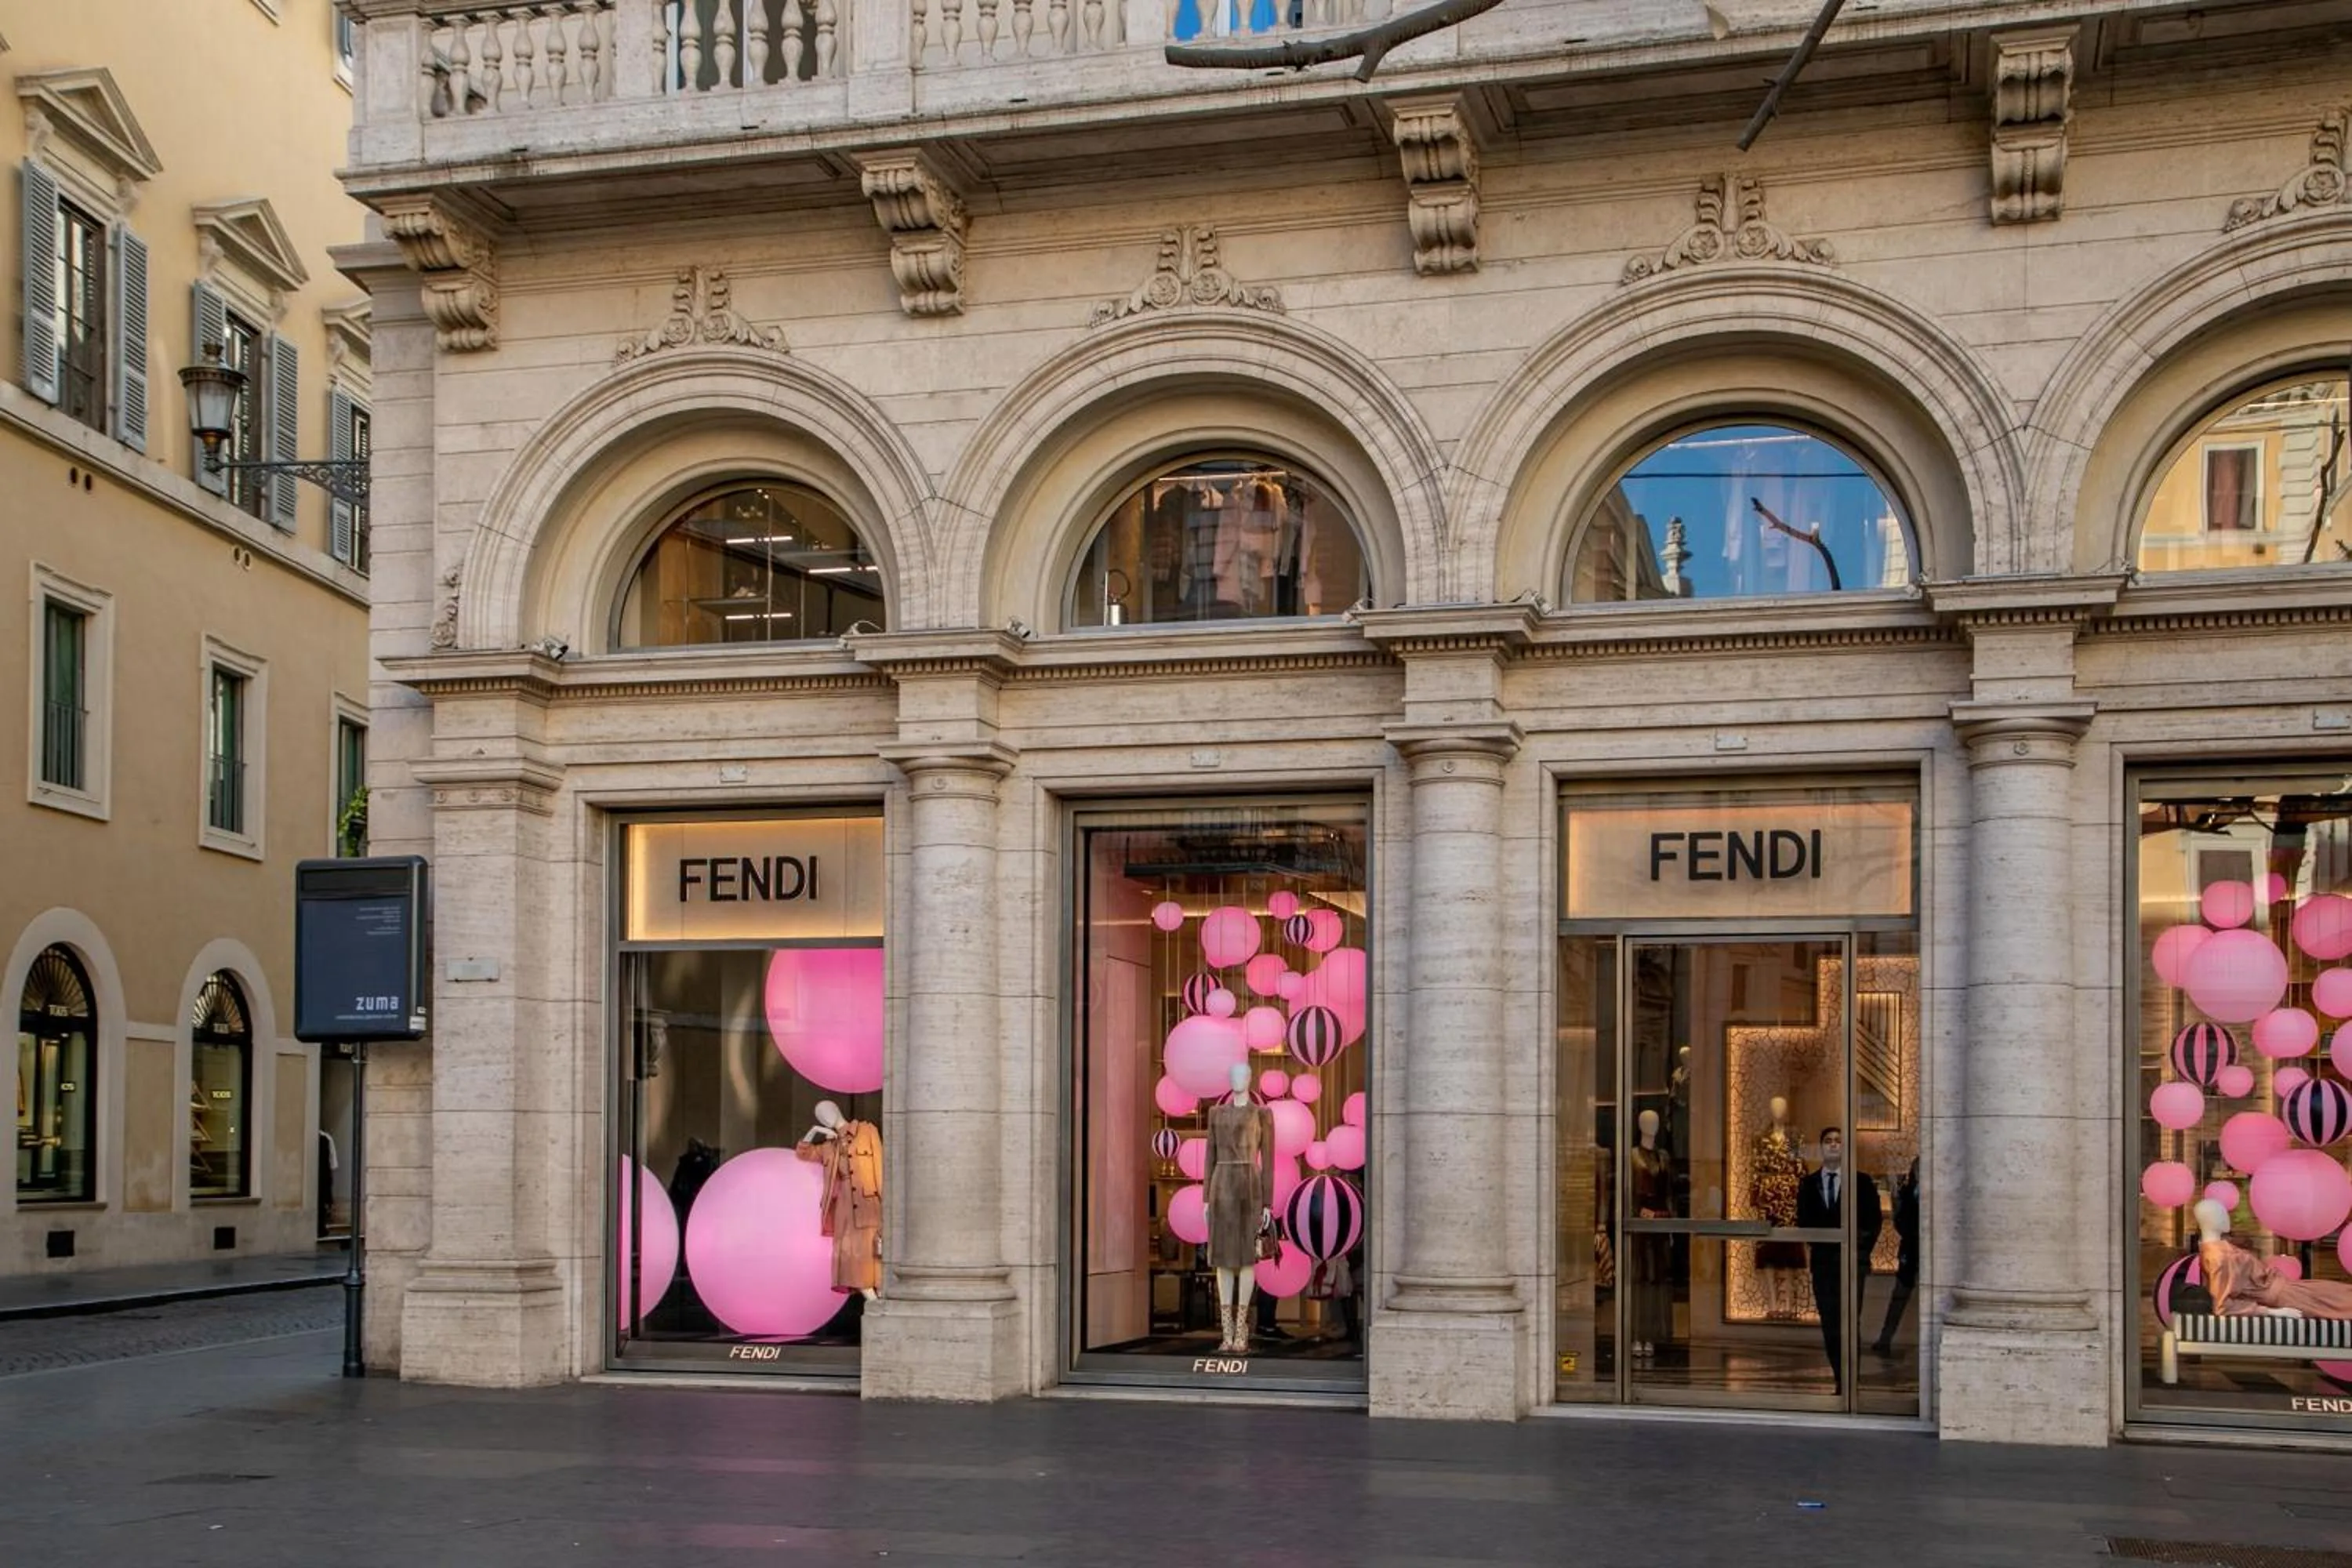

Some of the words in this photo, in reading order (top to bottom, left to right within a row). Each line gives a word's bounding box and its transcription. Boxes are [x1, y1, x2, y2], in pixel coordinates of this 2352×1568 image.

[1650, 829, 1821, 881] FENDI
[680, 856, 818, 902] FENDI
[355, 996, 400, 1011] zuma
[729, 1345, 782, 1360] FENDI
[1192, 1359, 1248, 1374] FENDI
